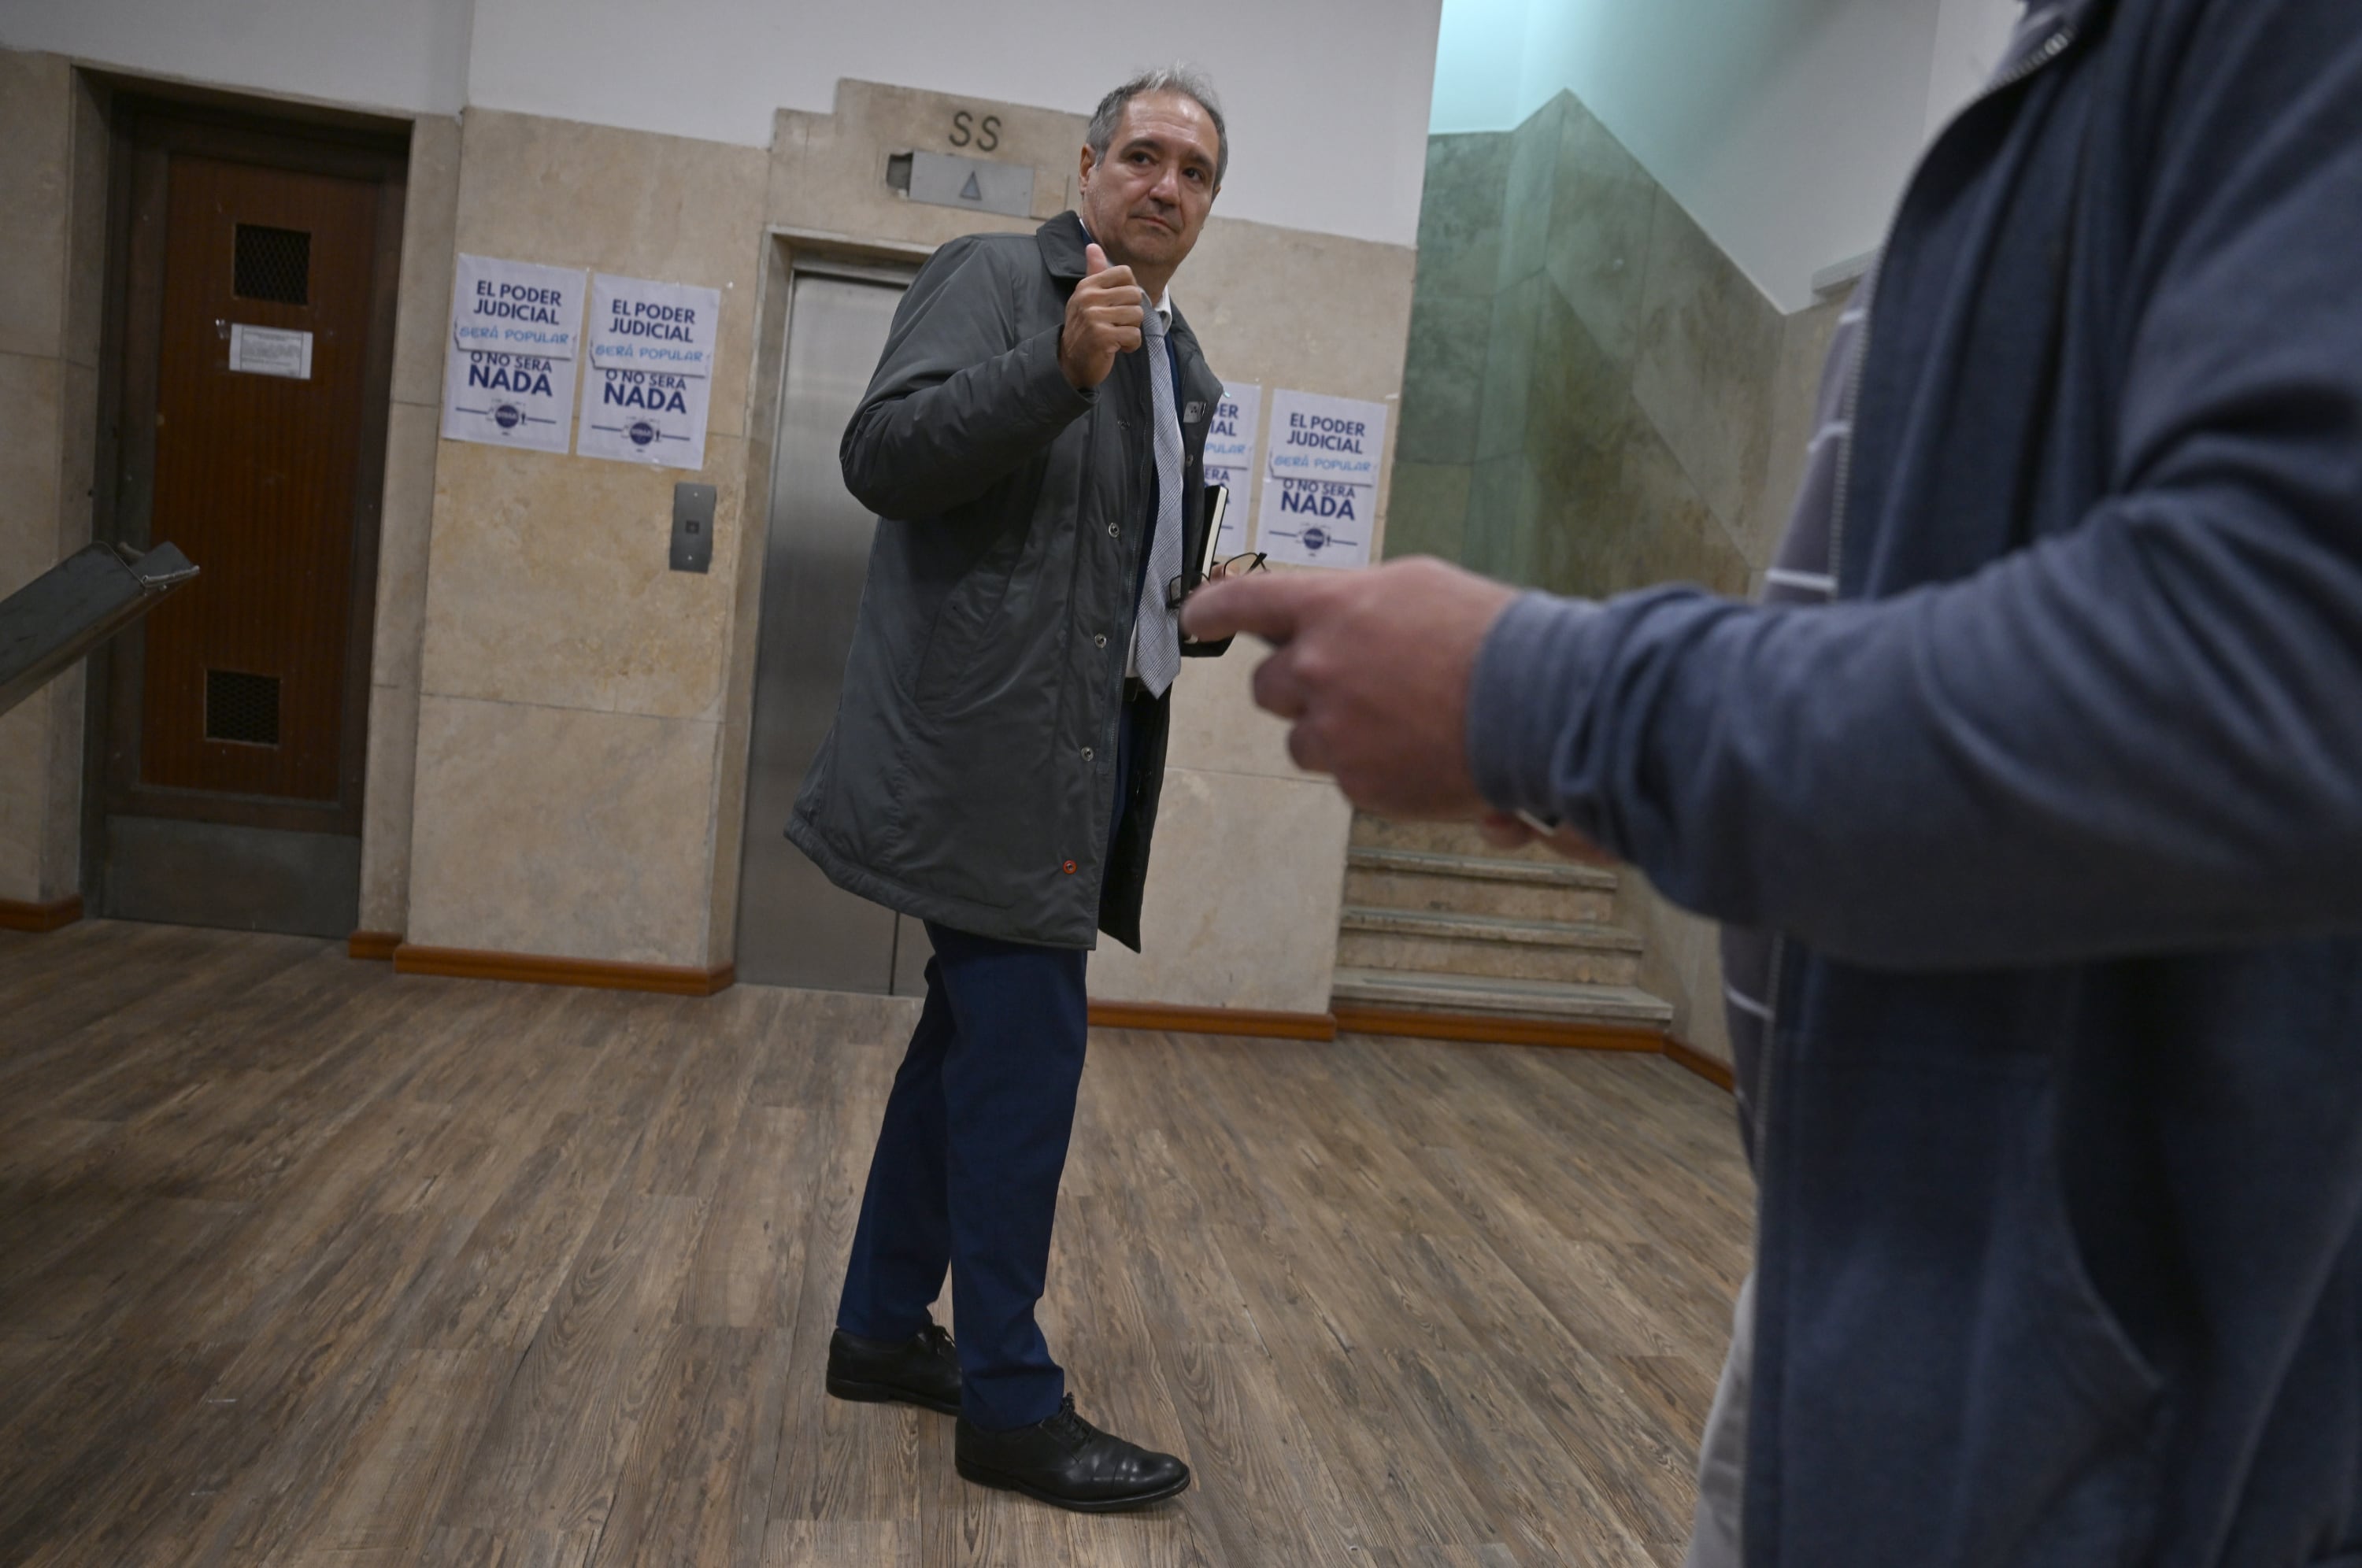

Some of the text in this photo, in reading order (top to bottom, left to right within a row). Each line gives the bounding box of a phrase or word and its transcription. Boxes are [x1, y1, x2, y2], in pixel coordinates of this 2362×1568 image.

[949, 110, 1001, 152] SS
[476, 280, 561, 306] EL PODER
[473, 299, 560, 325] JUDICIAL
[612, 299, 695, 325] EL PODER
[505, 329, 568, 344] POPULAR
[609, 318, 694, 343] JUDICIAL
[471, 351, 483, 363] O
[487, 353, 510, 367] NO
[639, 347, 703, 362] POPULAR
[468, 364, 553, 398] NADA
[605, 368, 618, 381] O
[622, 370, 645, 384] NO
[604, 382, 687, 414] NADA
[1290, 412, 1365, 437] EL PODER
[1287, 431, 1363, 454] JUDICIAL
[1314, 458, 1371, 471] POPULAR
[1283, 478, 1294, 490] O
[1298, 479, 1319, 493] NO
[1281, 490, 1356, 521] NADA
